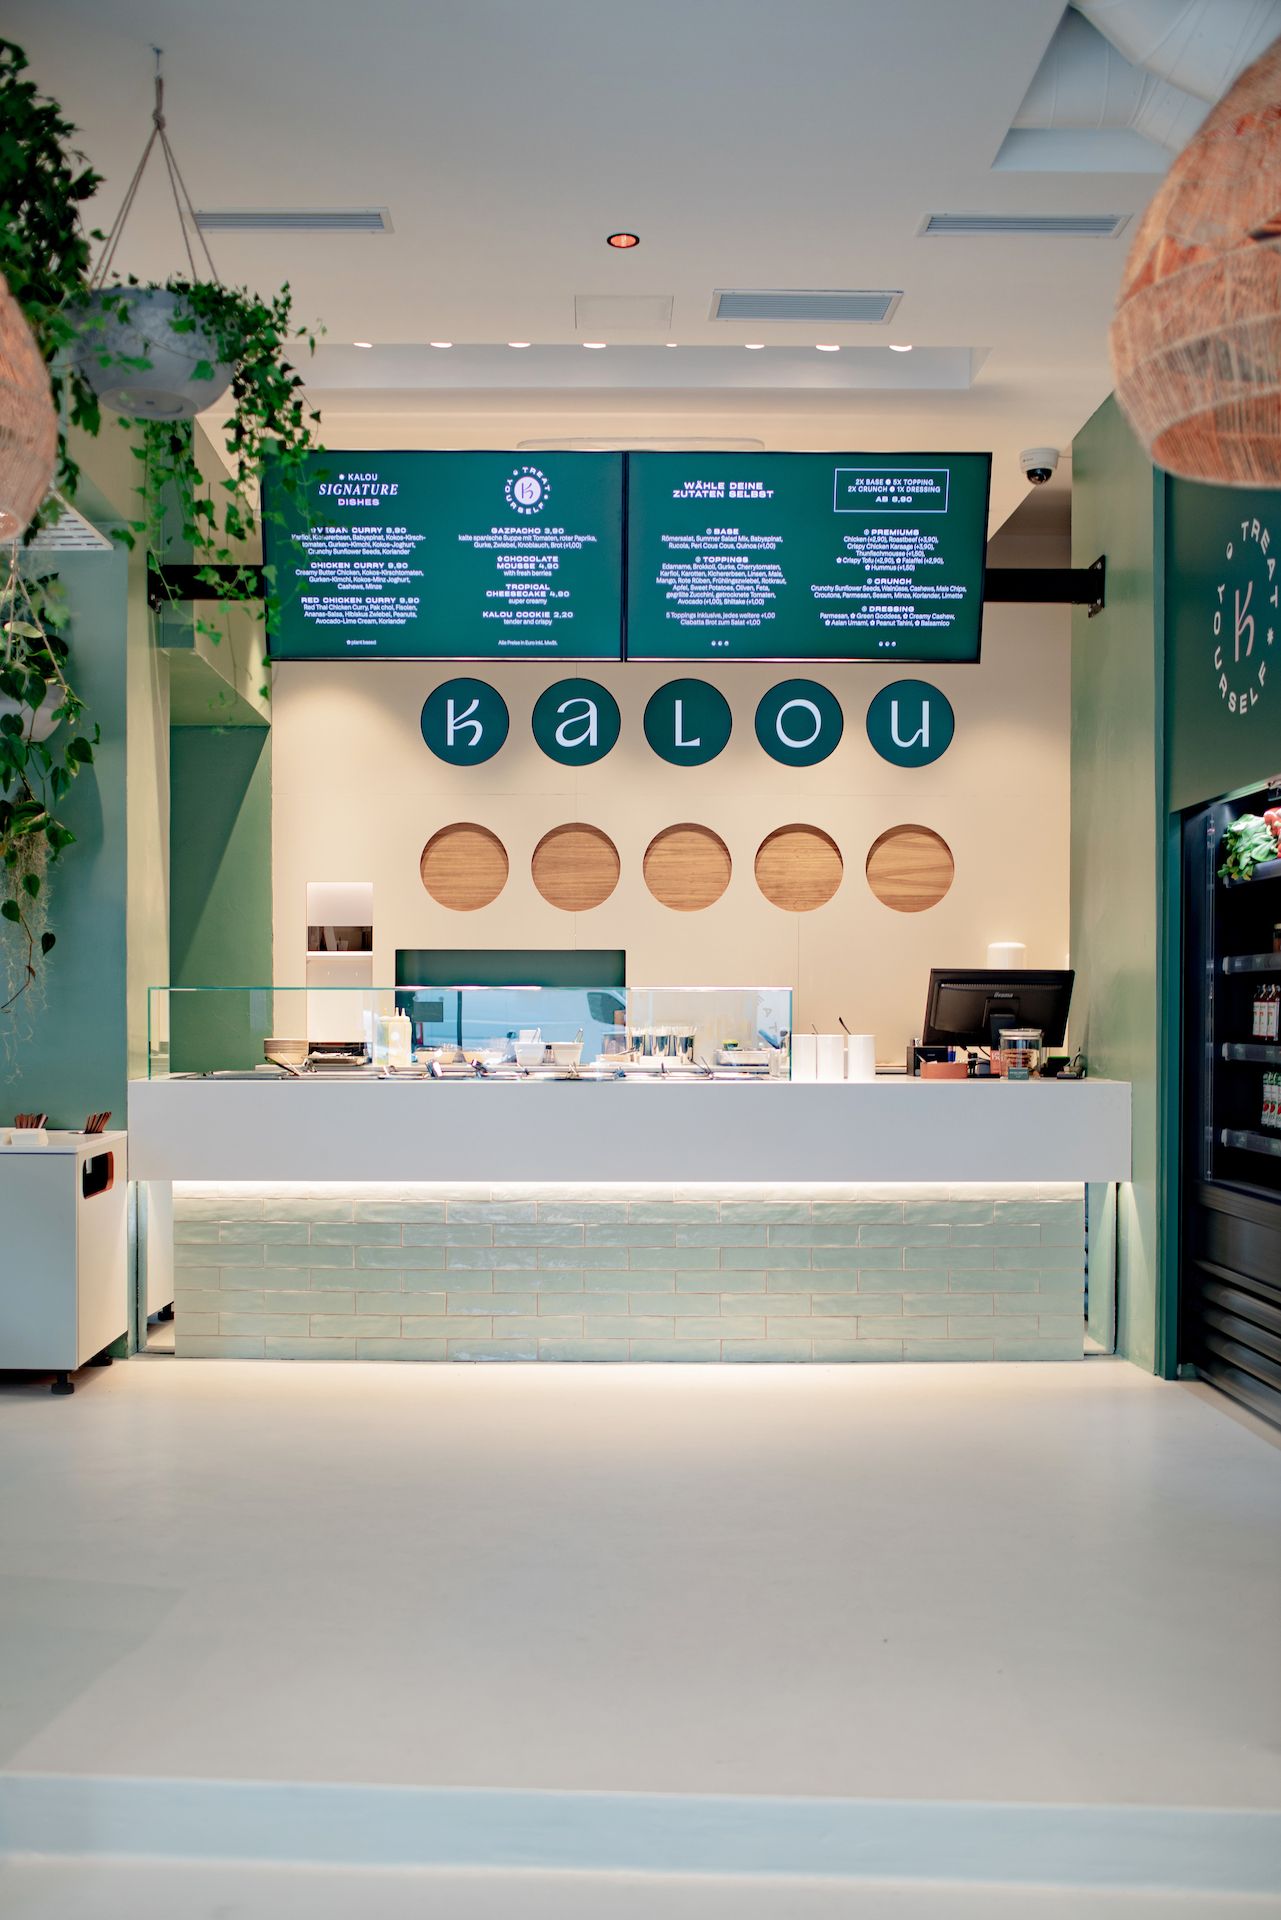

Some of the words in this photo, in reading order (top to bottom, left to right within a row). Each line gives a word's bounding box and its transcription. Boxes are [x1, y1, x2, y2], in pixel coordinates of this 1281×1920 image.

[319, 484, 398, 496] SIGNATURE
[522, 467, 551, 491] TREAT
[684, 482, 725, 490] WÄHLE
[730, 482, 763, 490] DEINE
[505, 479, 545, 514] YOURSELF
[1241, 517, 1278, 608] TREAT
[1213, 583, 1266, 715] YOURSELF
